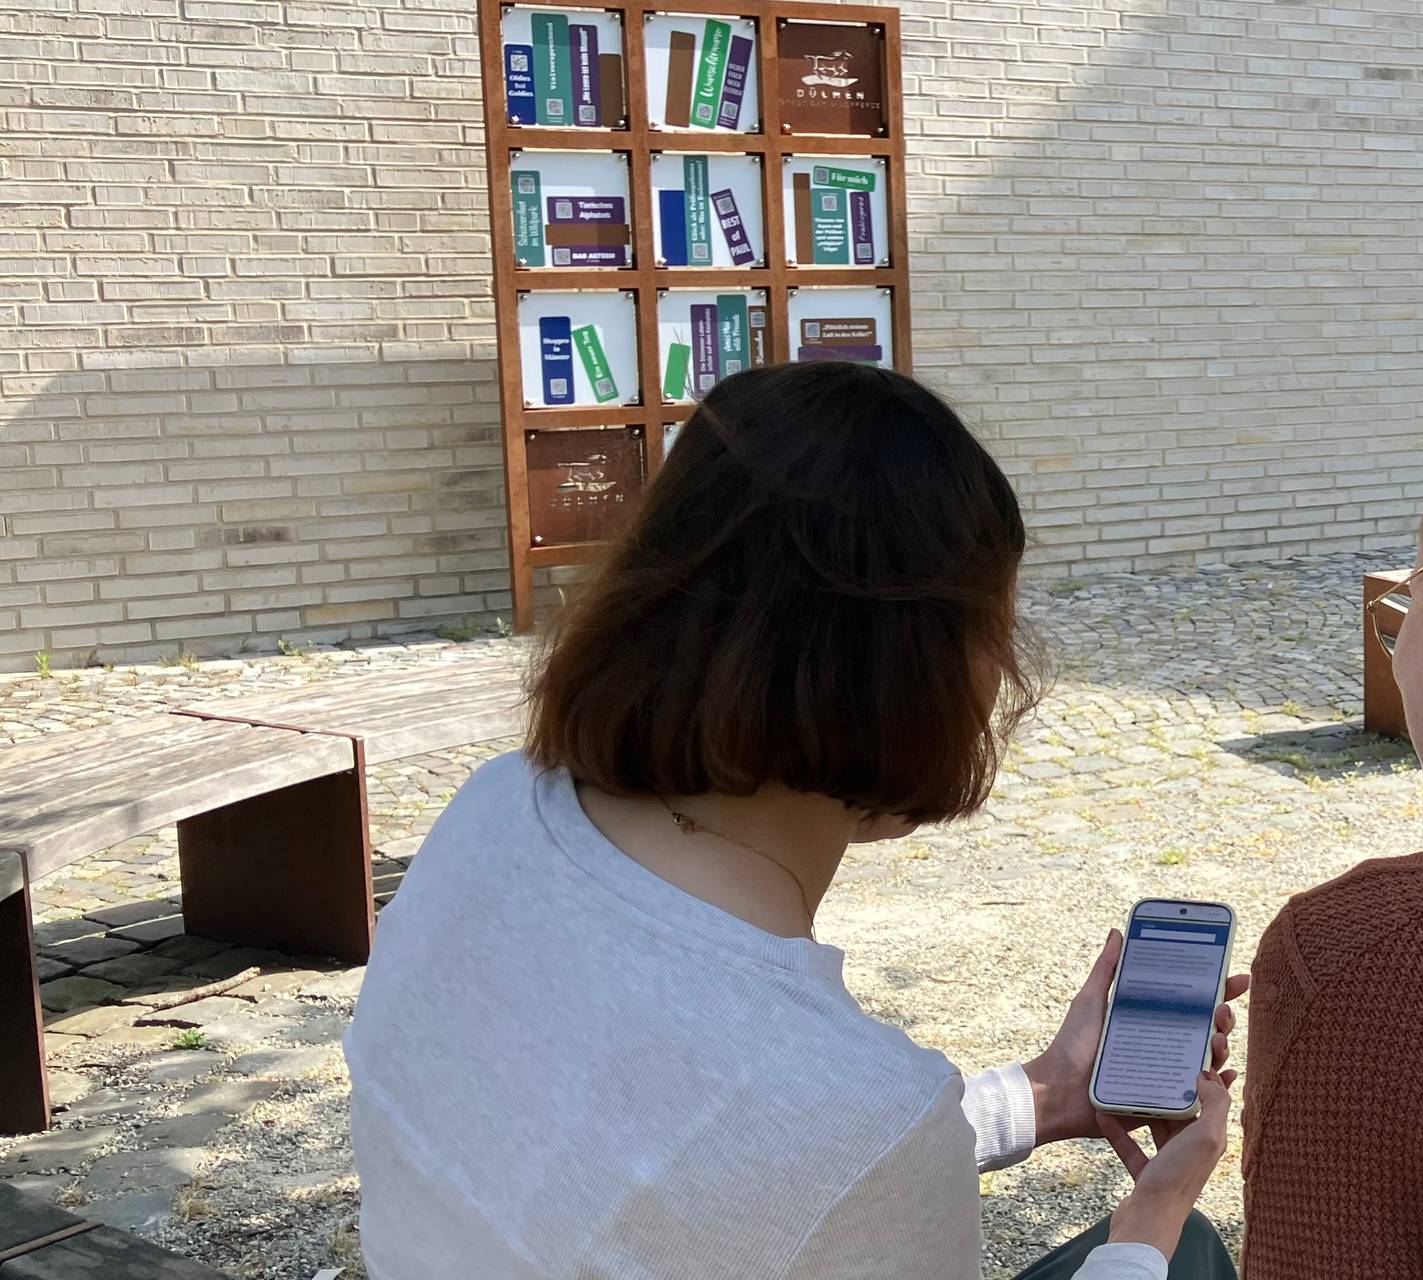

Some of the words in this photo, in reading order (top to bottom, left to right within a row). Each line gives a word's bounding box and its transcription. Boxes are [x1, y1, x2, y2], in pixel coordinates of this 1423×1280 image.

[796, 87, 864, 100] DÜLMEN
[720, 215, 741, 229] BEST
[731, 230, 741, 241] of
[595, 366, 603, 378] Ein
